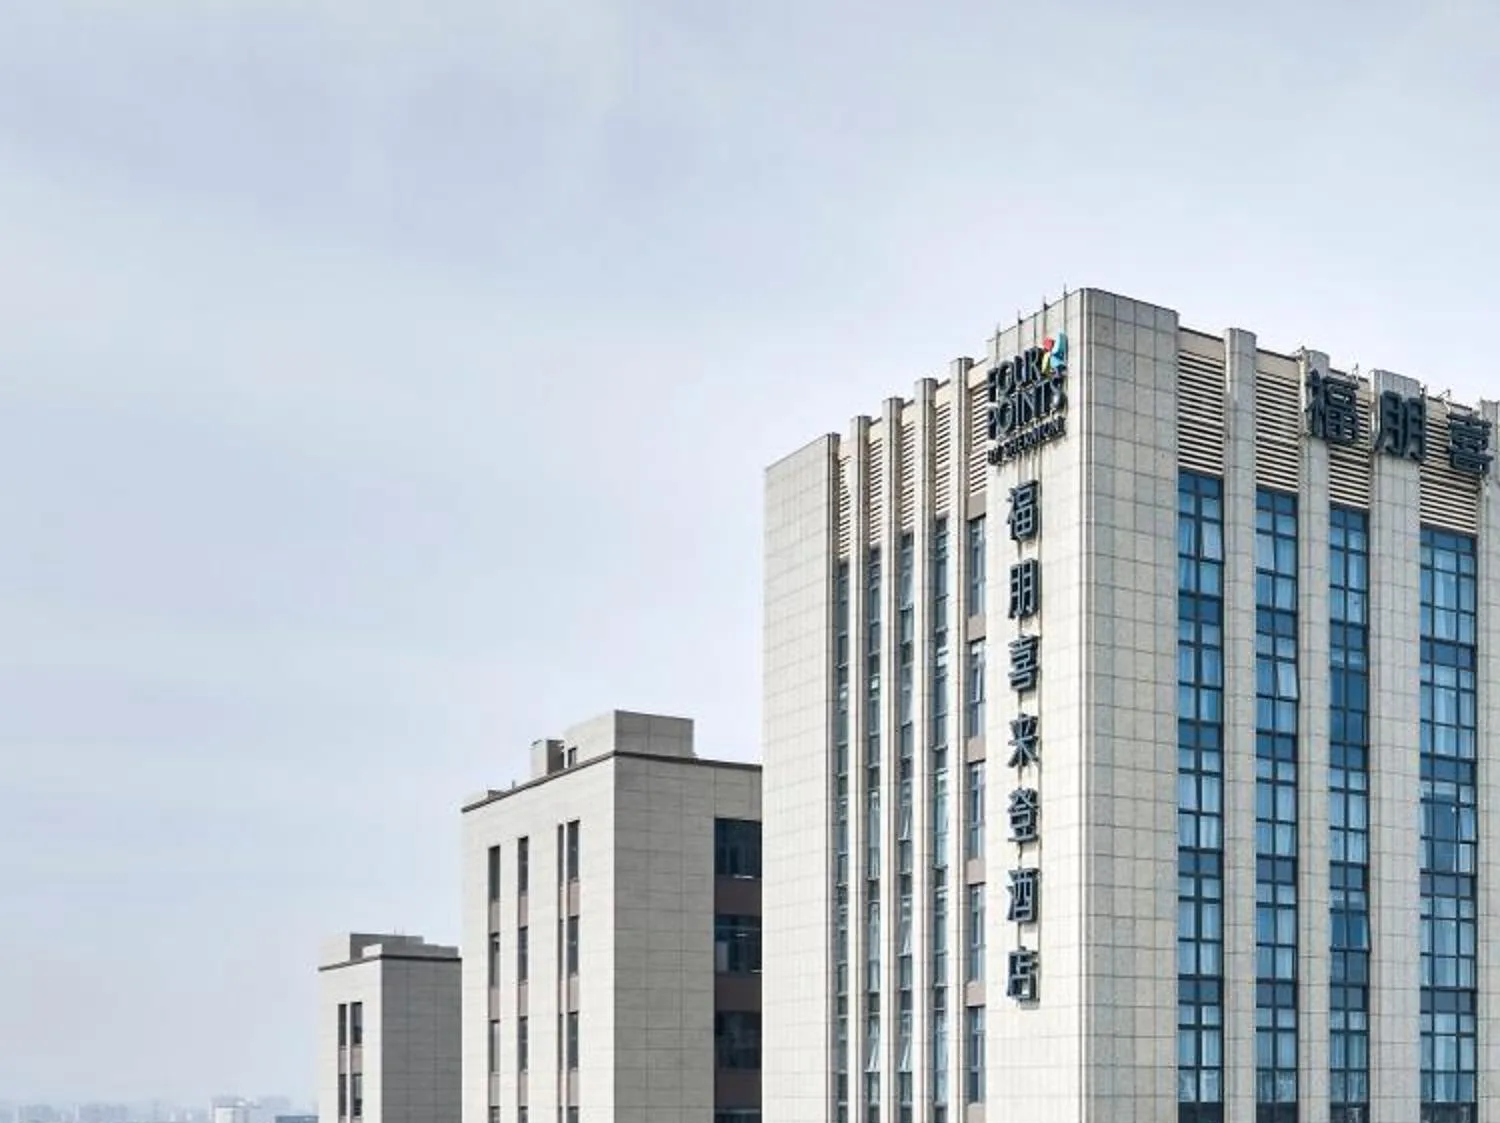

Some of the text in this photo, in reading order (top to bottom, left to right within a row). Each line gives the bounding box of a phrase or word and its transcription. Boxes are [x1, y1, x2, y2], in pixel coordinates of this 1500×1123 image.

[987, 346, 1044, 402] FOUR
[987, 377, 1067, 440] POINTS
[1006, 479, 1039, 1001] 福朋喜来登酒店
